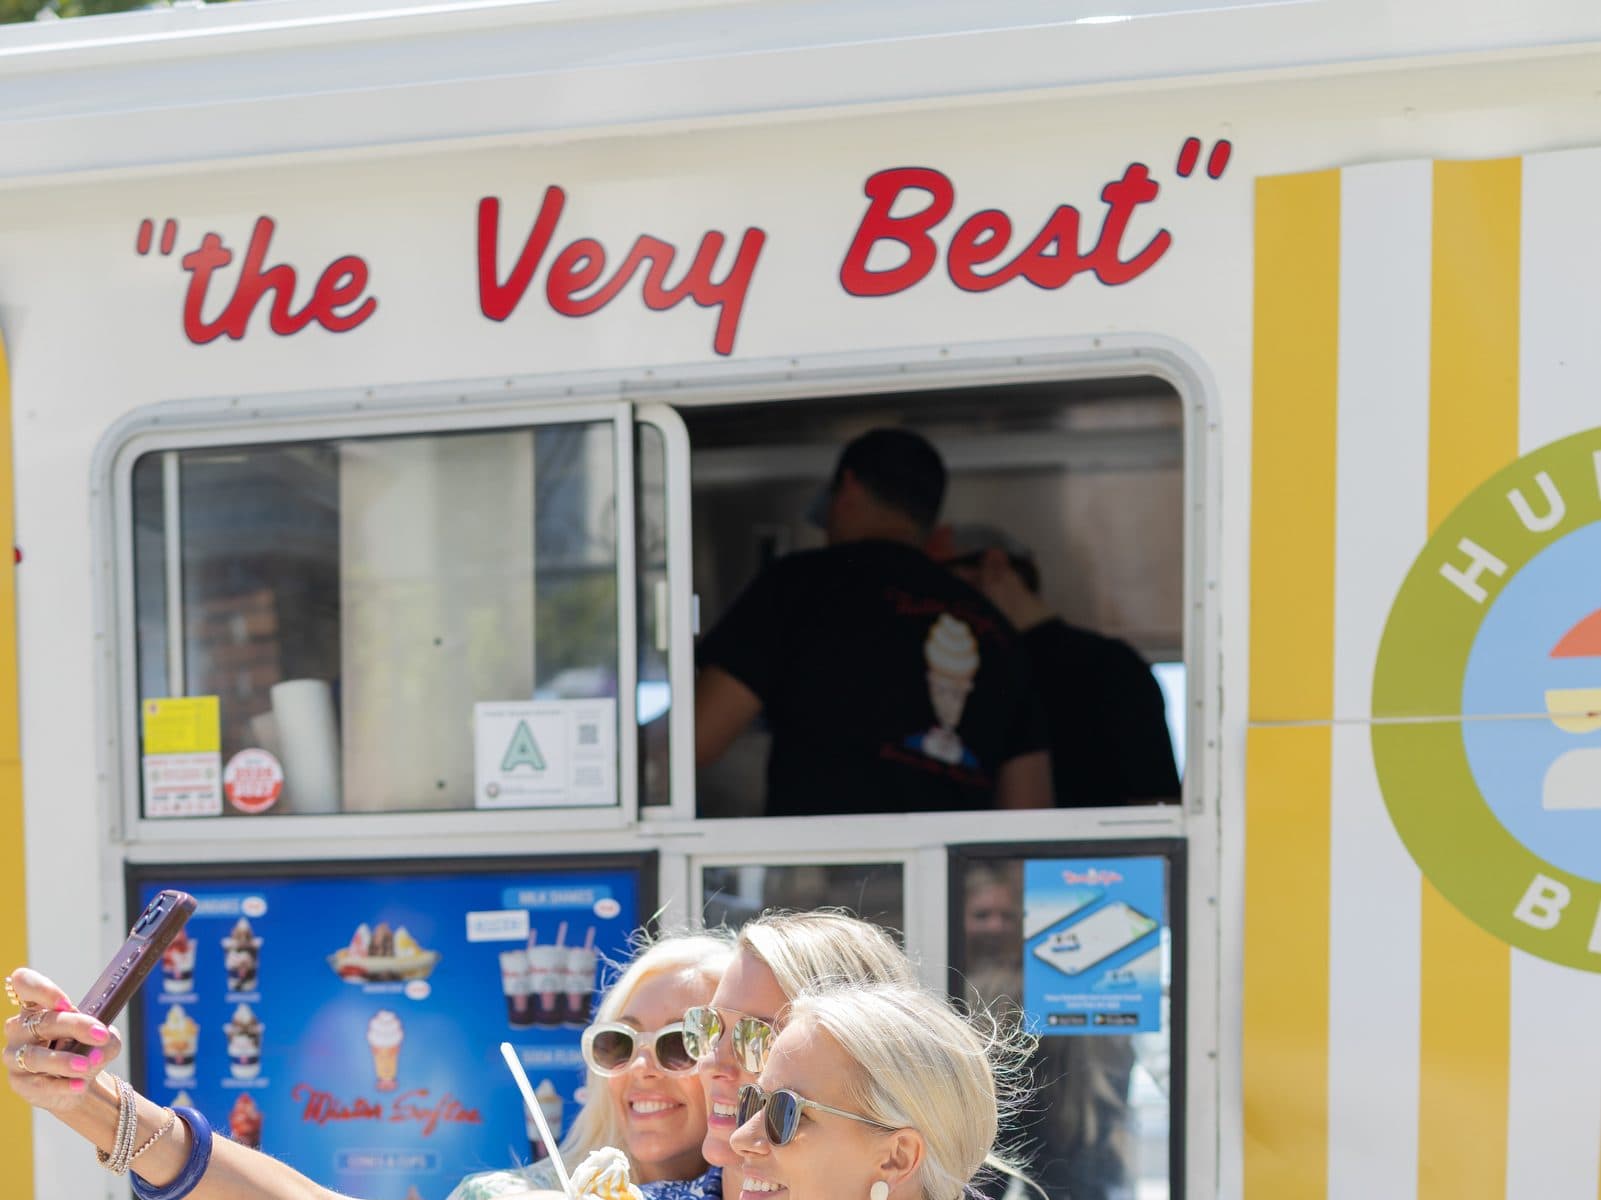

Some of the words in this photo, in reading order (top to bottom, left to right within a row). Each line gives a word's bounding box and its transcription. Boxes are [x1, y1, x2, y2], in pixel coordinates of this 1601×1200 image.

[136, 216, 378, 345] "the
[476, 185, 767, 356] Very
[839, 137, 1232, 297] Best"
[1439, 450, 1601, 604] HU
[501, 719, 546, 771] A
